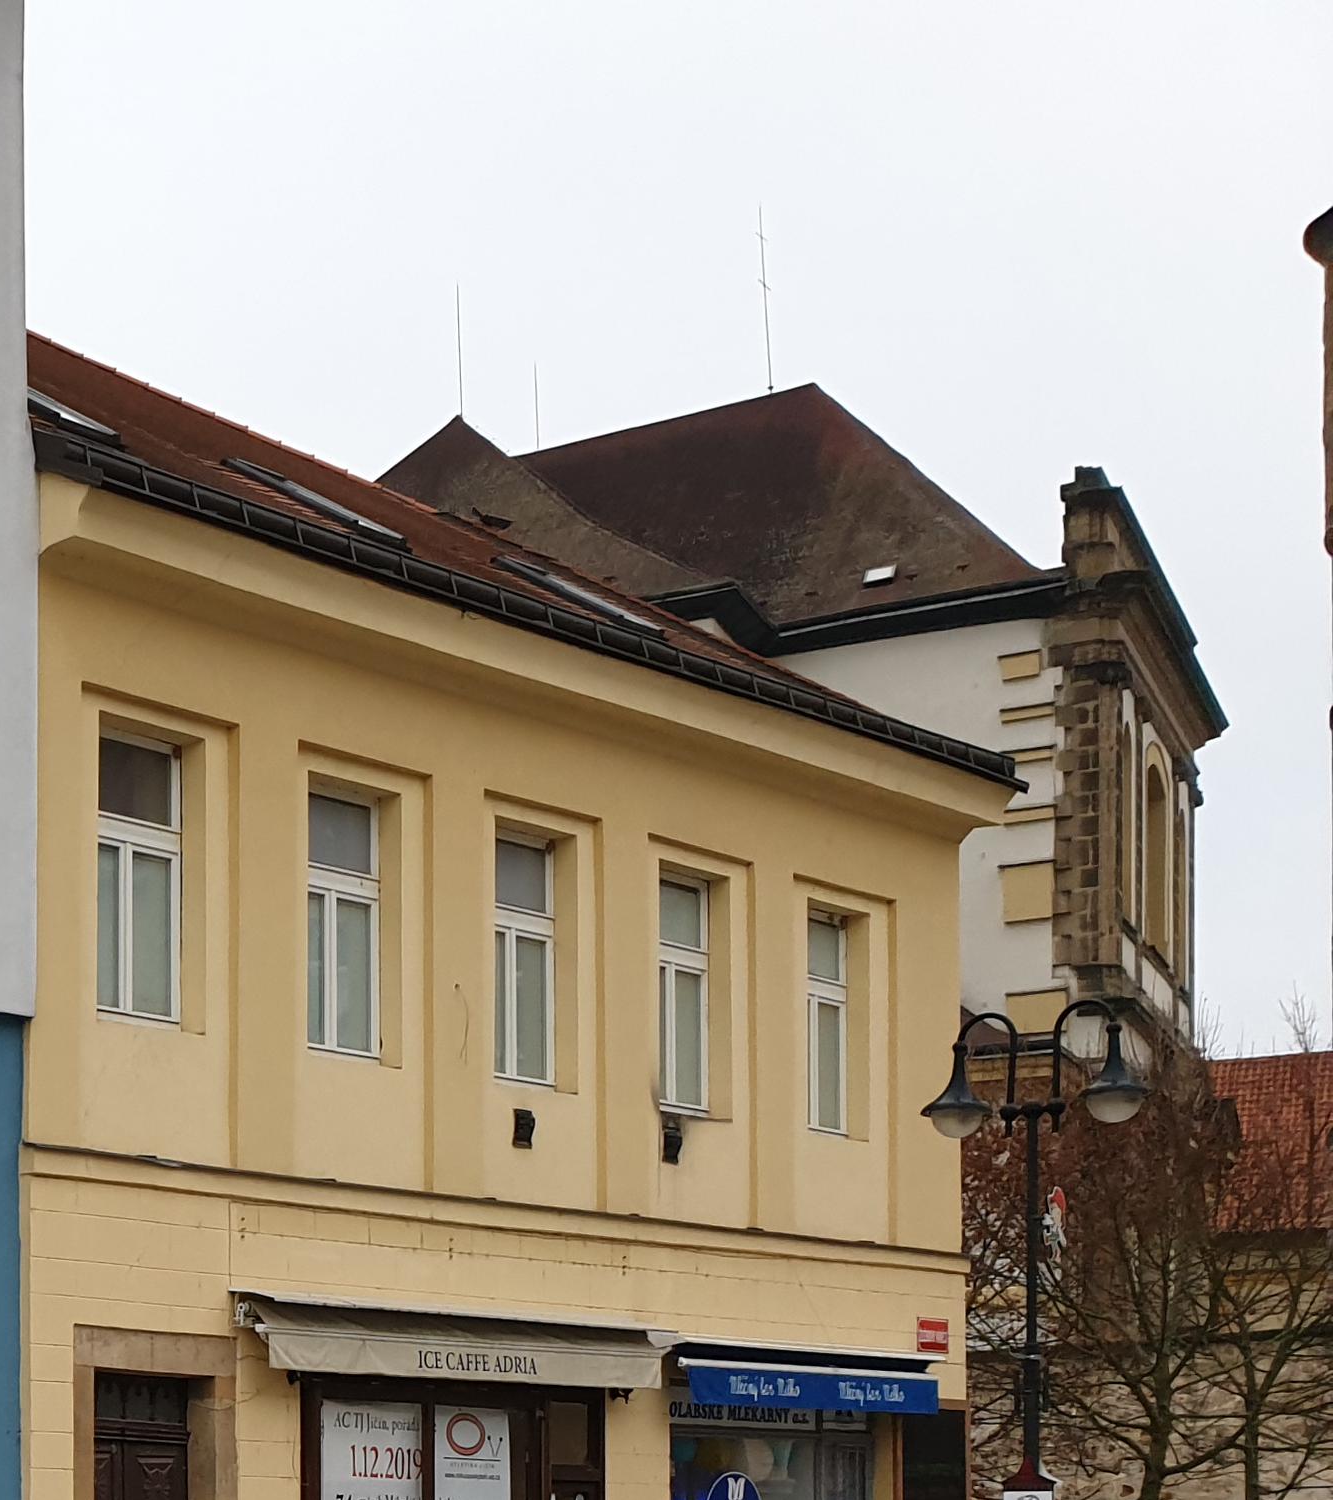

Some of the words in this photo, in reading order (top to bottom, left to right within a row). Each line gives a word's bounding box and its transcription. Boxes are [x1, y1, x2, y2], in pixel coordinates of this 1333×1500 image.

[418, 1350, 443, 1369] ICE
[446, 1352, 490, 1372] CAFFE
[494, 1356, 537, 1375] ADRIA
[350, 1445, 422, 1480] 1.12.2019
